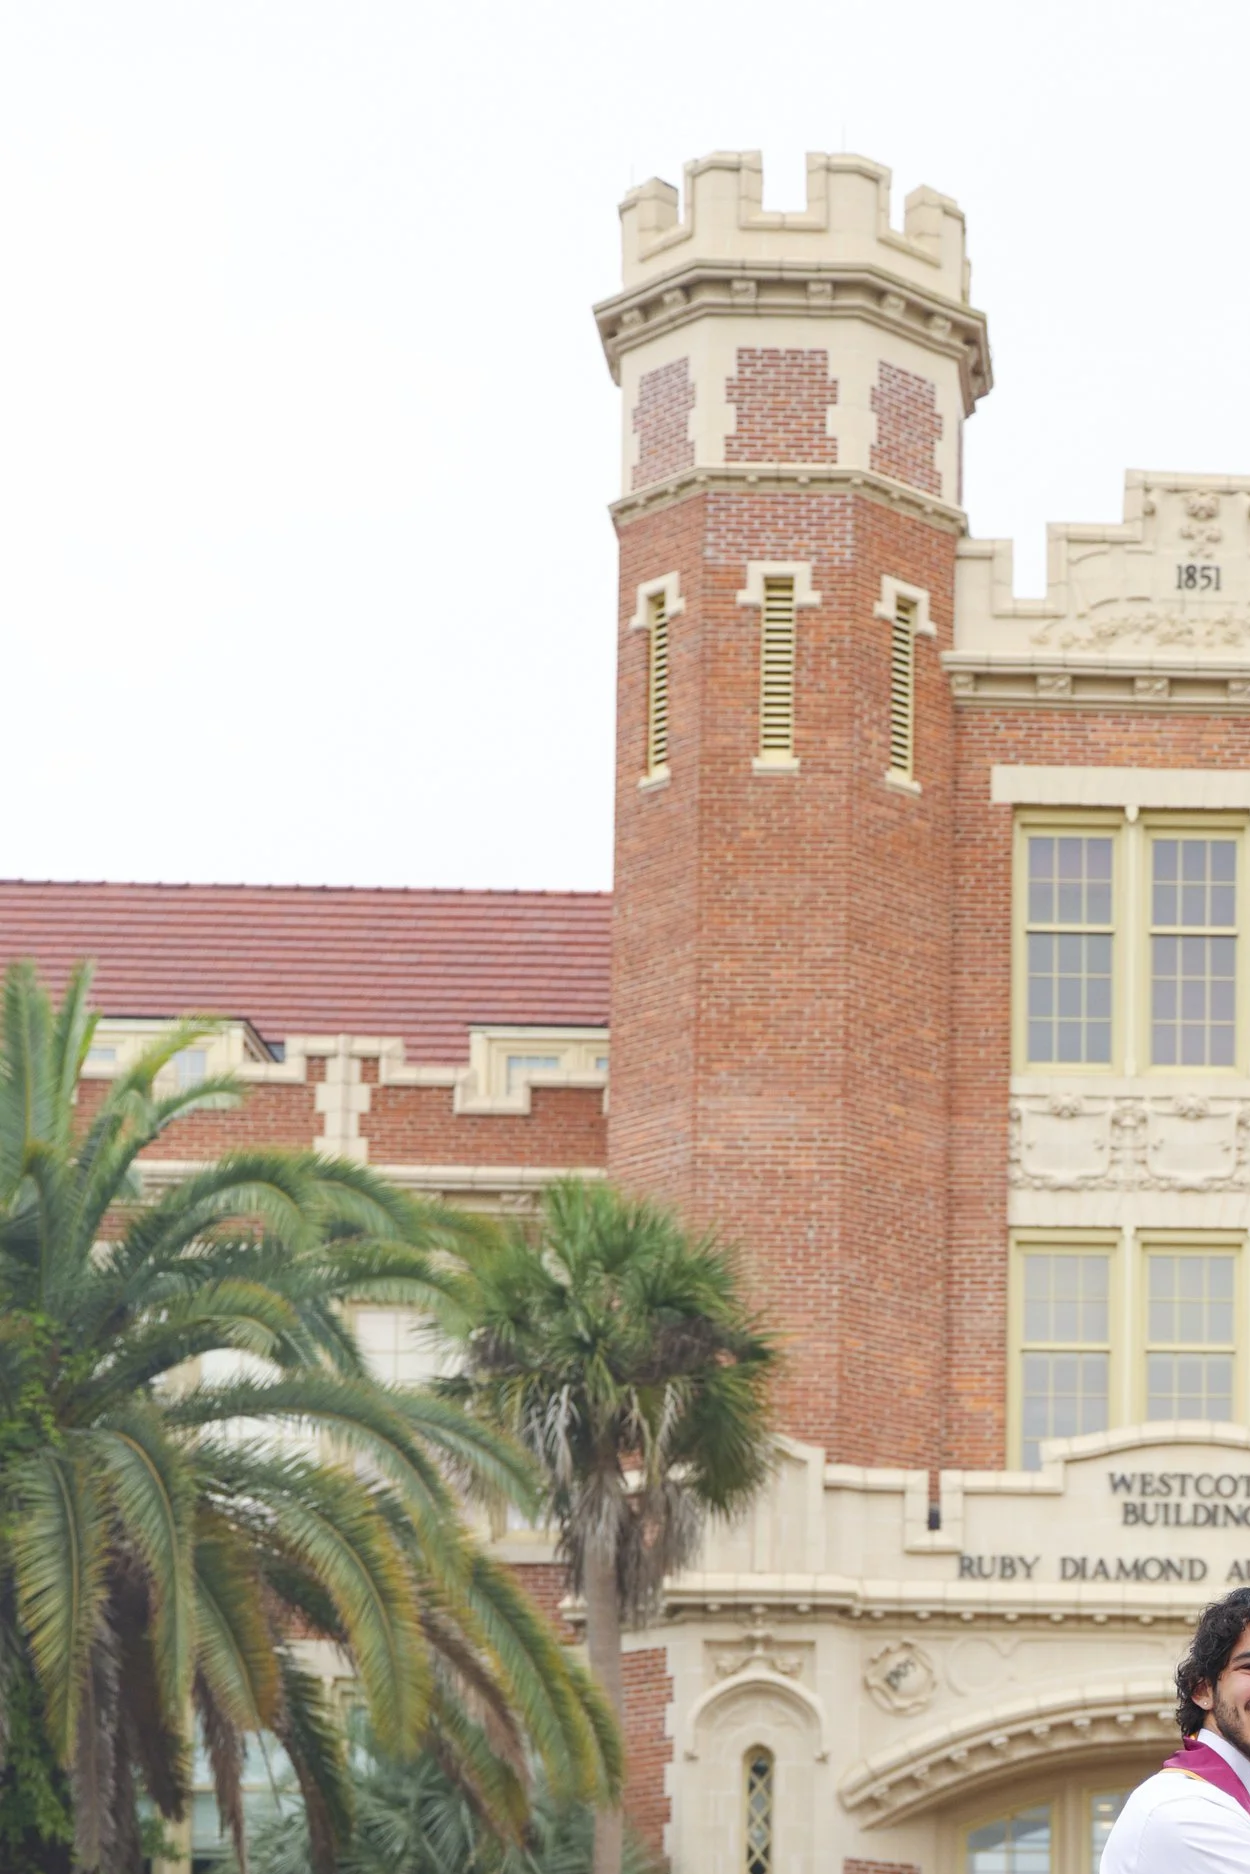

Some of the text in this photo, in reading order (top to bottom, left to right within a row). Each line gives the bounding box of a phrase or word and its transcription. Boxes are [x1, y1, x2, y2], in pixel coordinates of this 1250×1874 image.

[1176, 563, 1222, 591] 1851
[957, 1554, 1041, 1580] RUBY
[1060, 1557, 1208, 1583] DIAMOND
